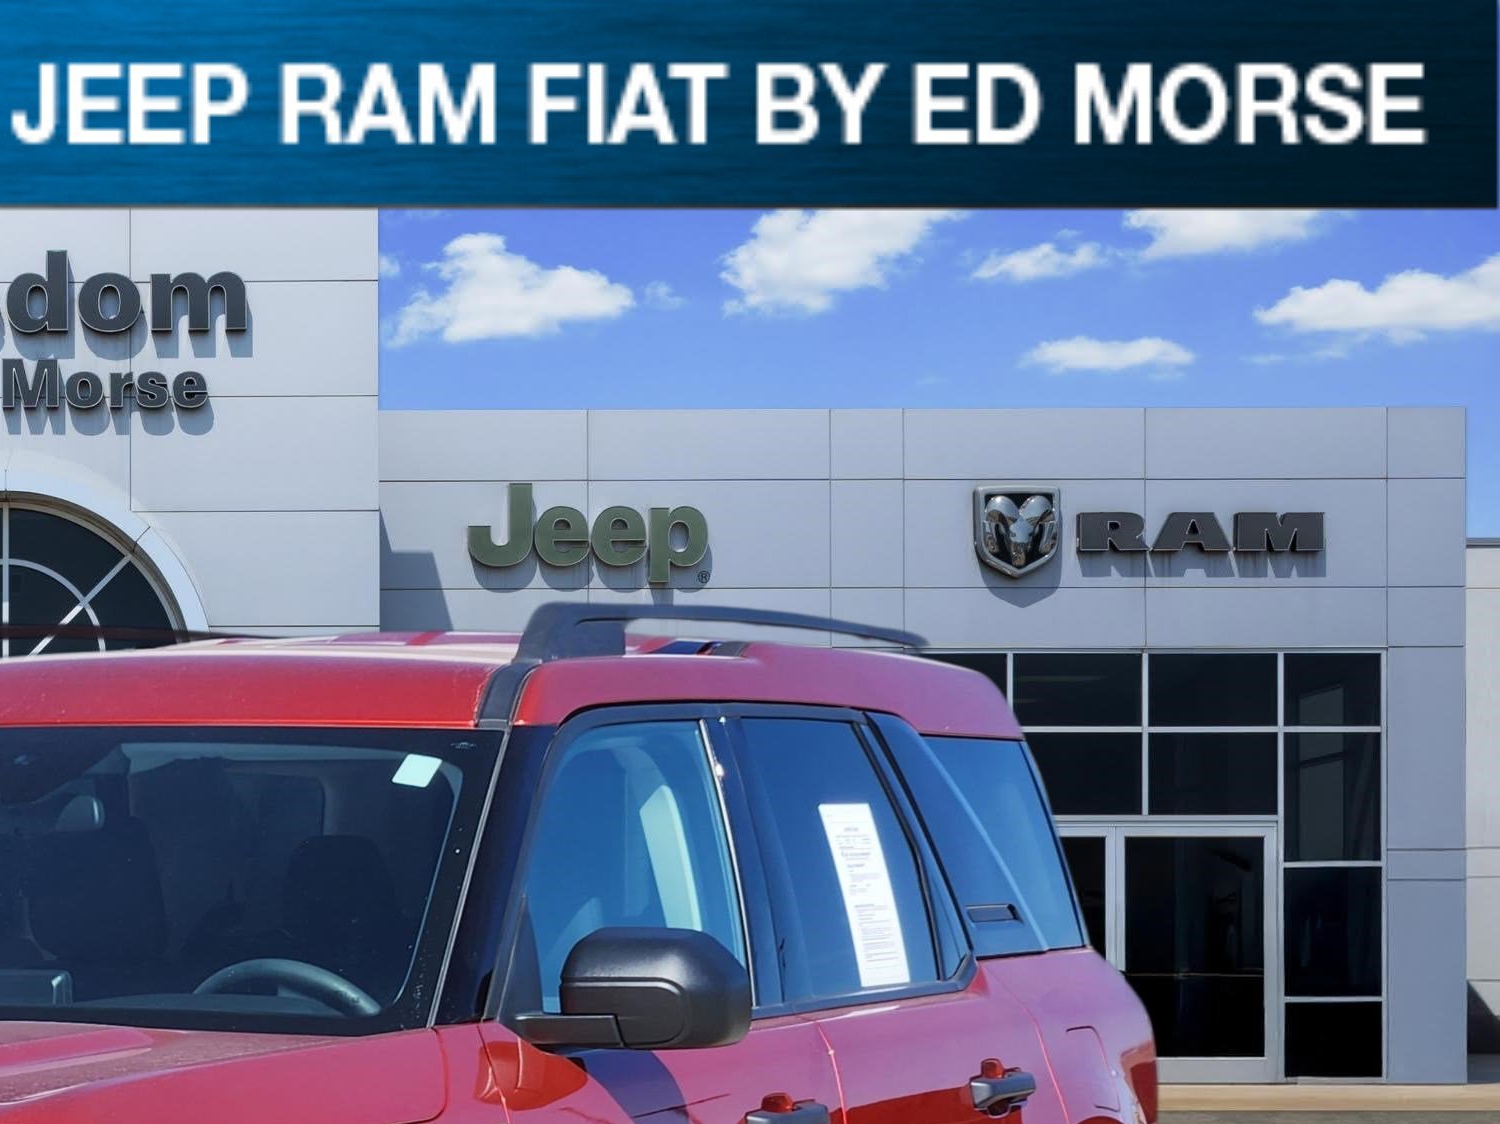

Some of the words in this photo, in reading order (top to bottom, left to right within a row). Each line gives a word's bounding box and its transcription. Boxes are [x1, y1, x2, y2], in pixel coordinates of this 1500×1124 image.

[2, 358, 209, 409] Morse
[467, 482, 709, 583] Jeep
[1076, 511, 1326, 552] RAM
